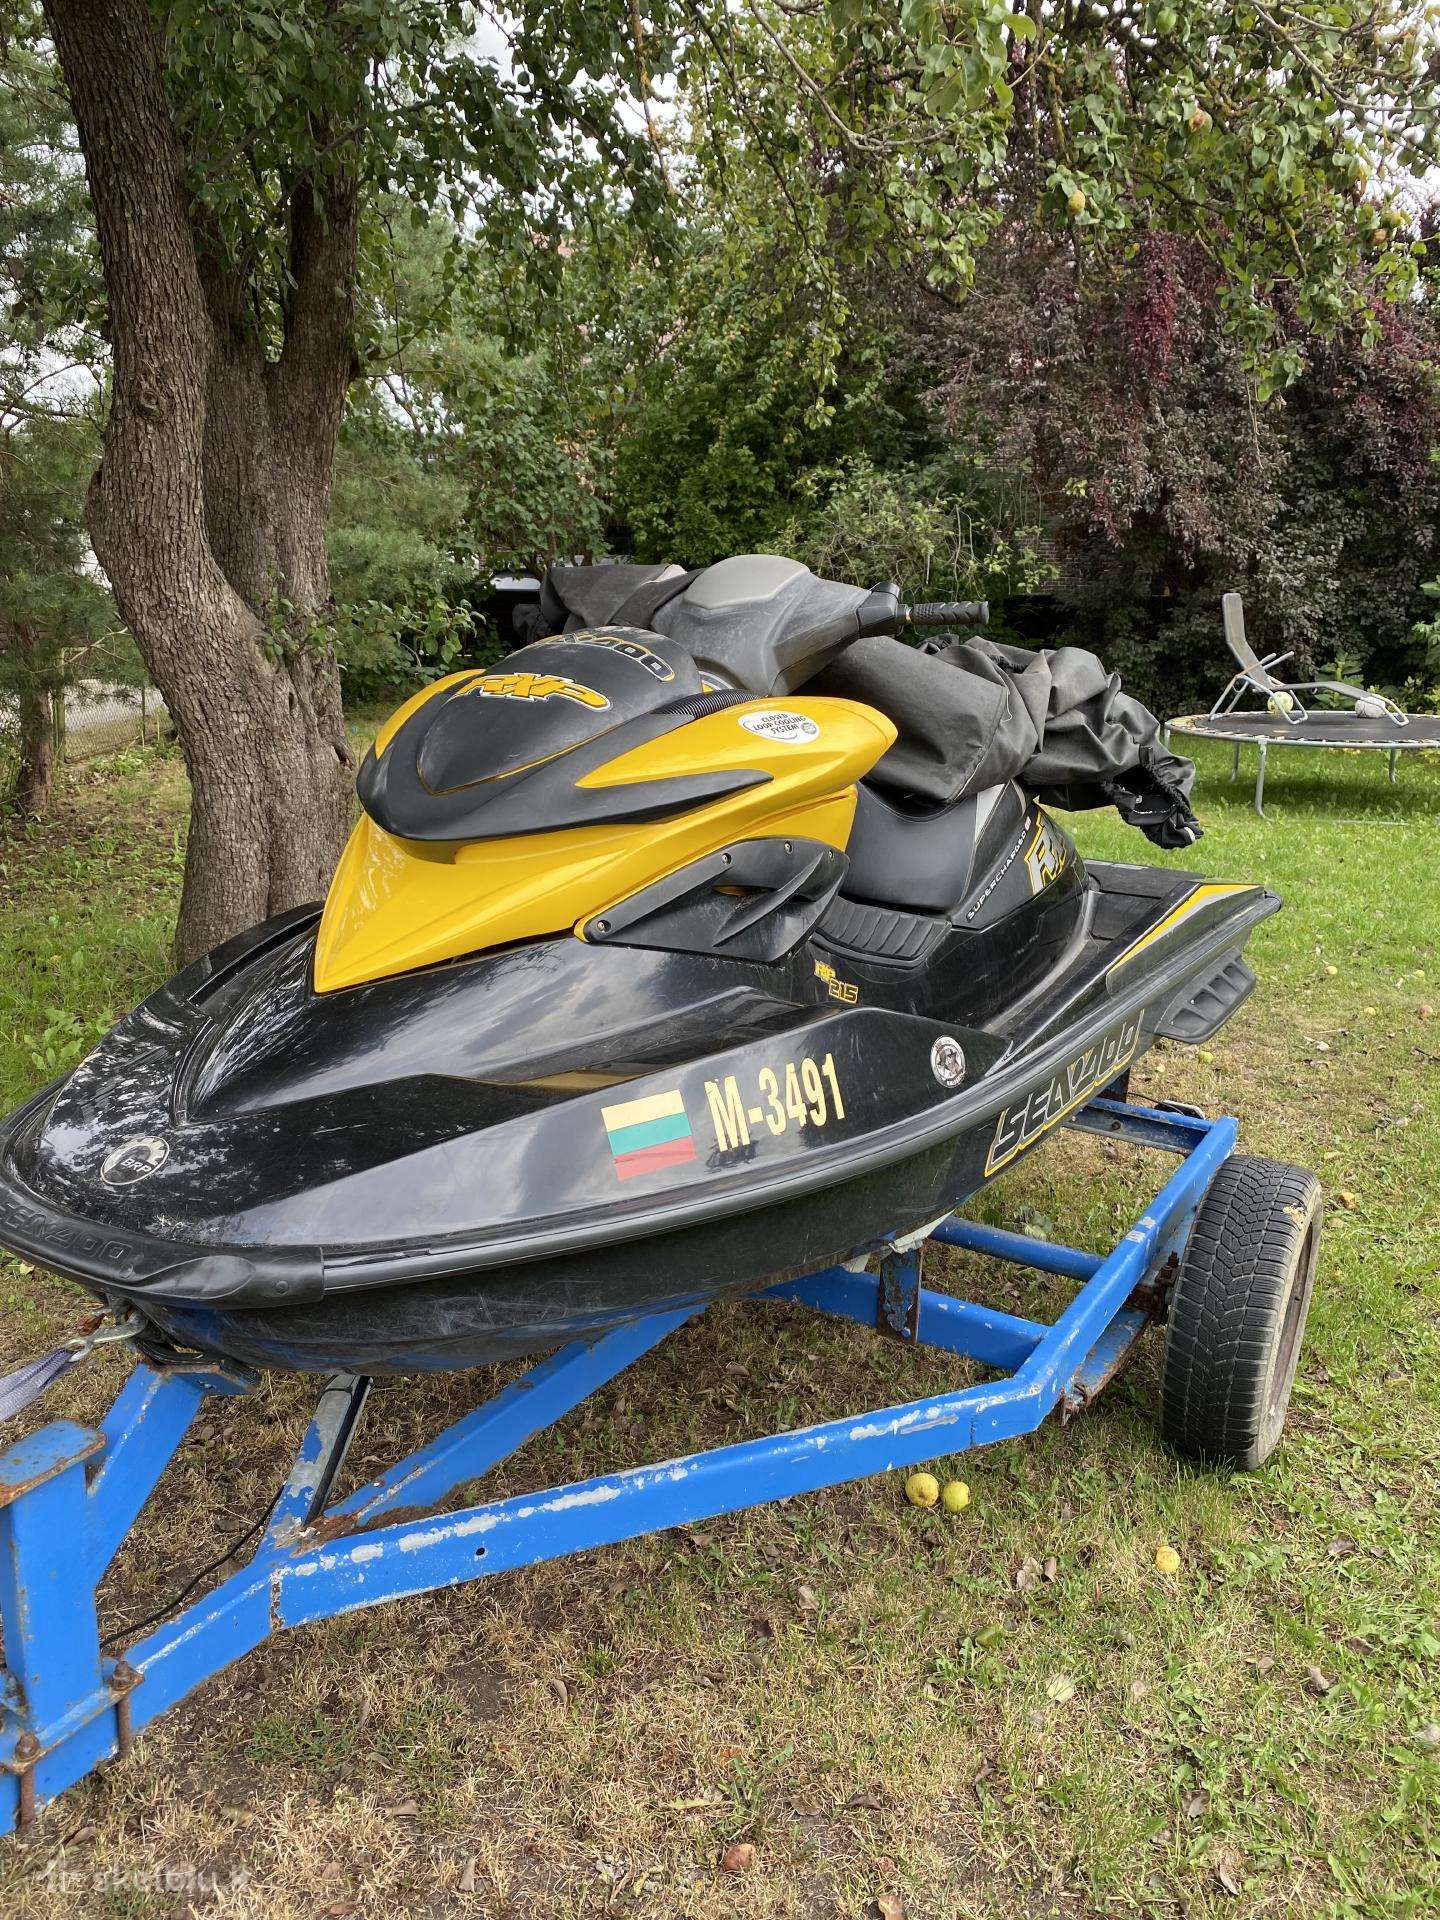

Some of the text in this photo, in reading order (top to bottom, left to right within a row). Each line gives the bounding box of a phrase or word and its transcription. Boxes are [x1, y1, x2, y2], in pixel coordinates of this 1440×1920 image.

[753, 715, 806, 731] LOOP COOLING
[761, 713, 788, 723] CLOSED
[771, 723, 799, 734] SYSTEM
[829, 978, 859, 1003] 215
[704, 1053, 845, 1152] M-3491
[121, 1158, 152, 1172] BRP
